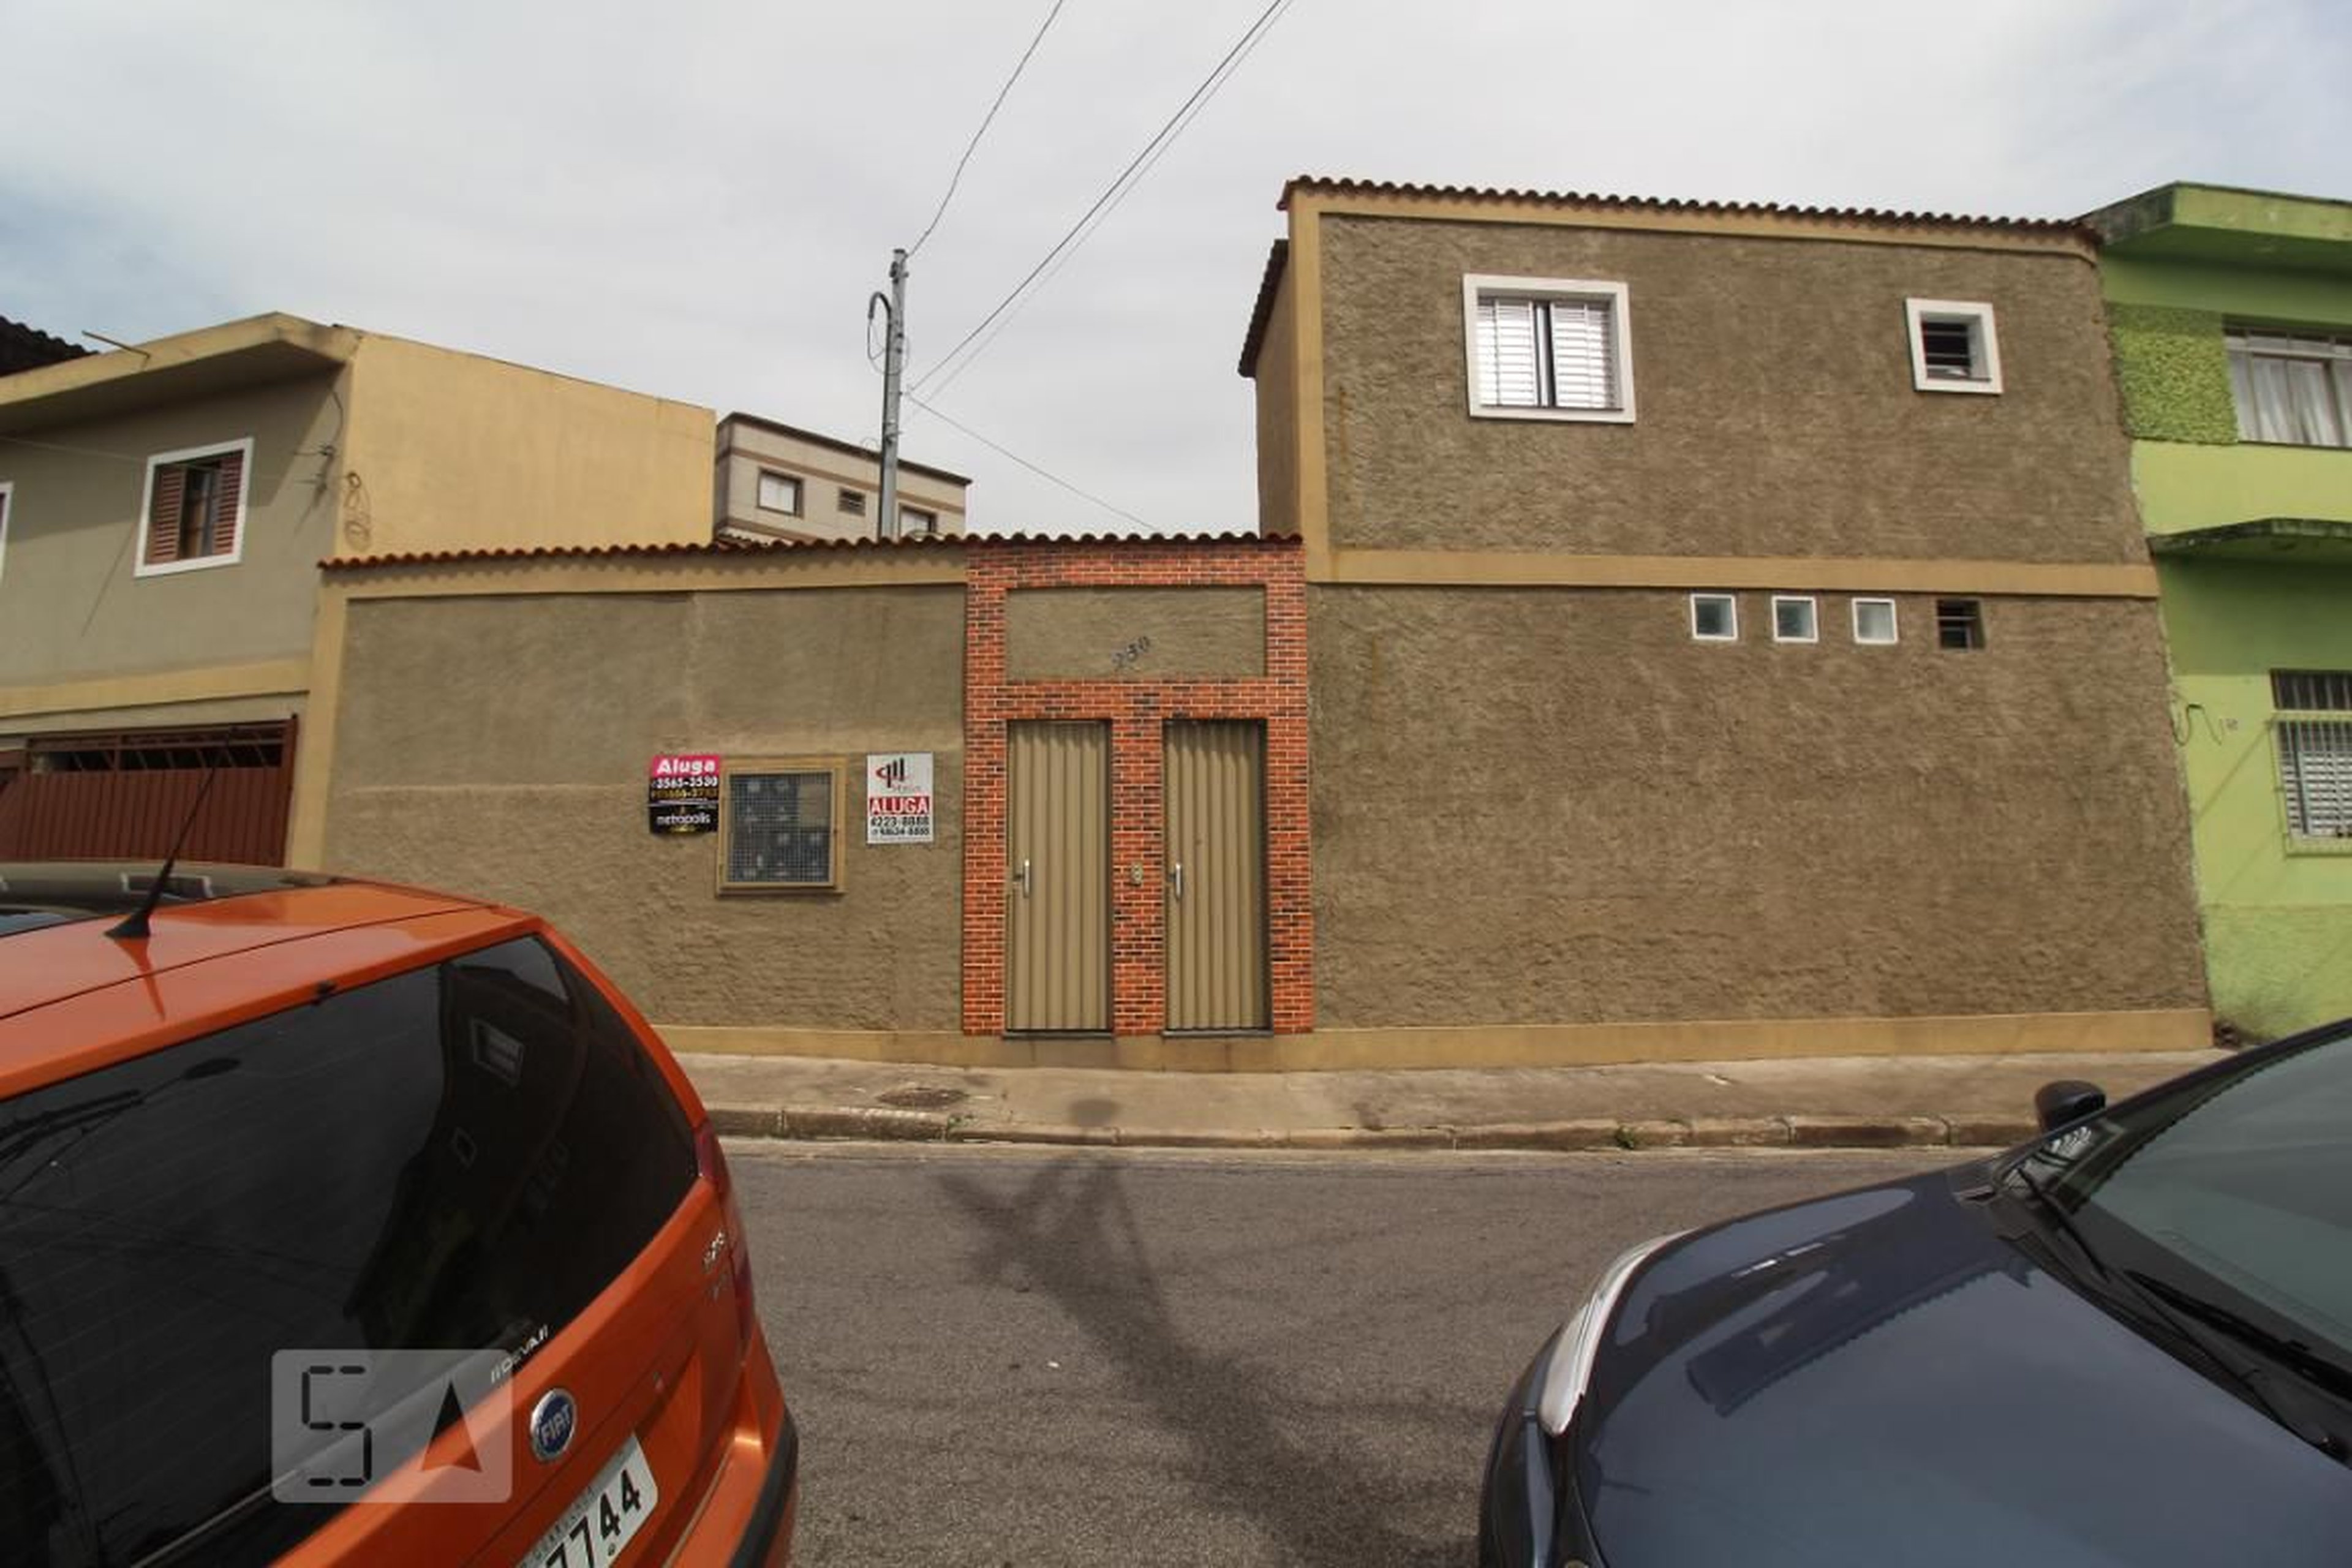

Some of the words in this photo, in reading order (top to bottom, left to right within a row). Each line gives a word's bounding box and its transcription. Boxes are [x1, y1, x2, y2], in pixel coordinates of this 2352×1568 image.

[656, 758, 716, 775] Aluga
[870, 797, 928, 815] ALUGA
[541, 1404, 571, 1446] FIAT
